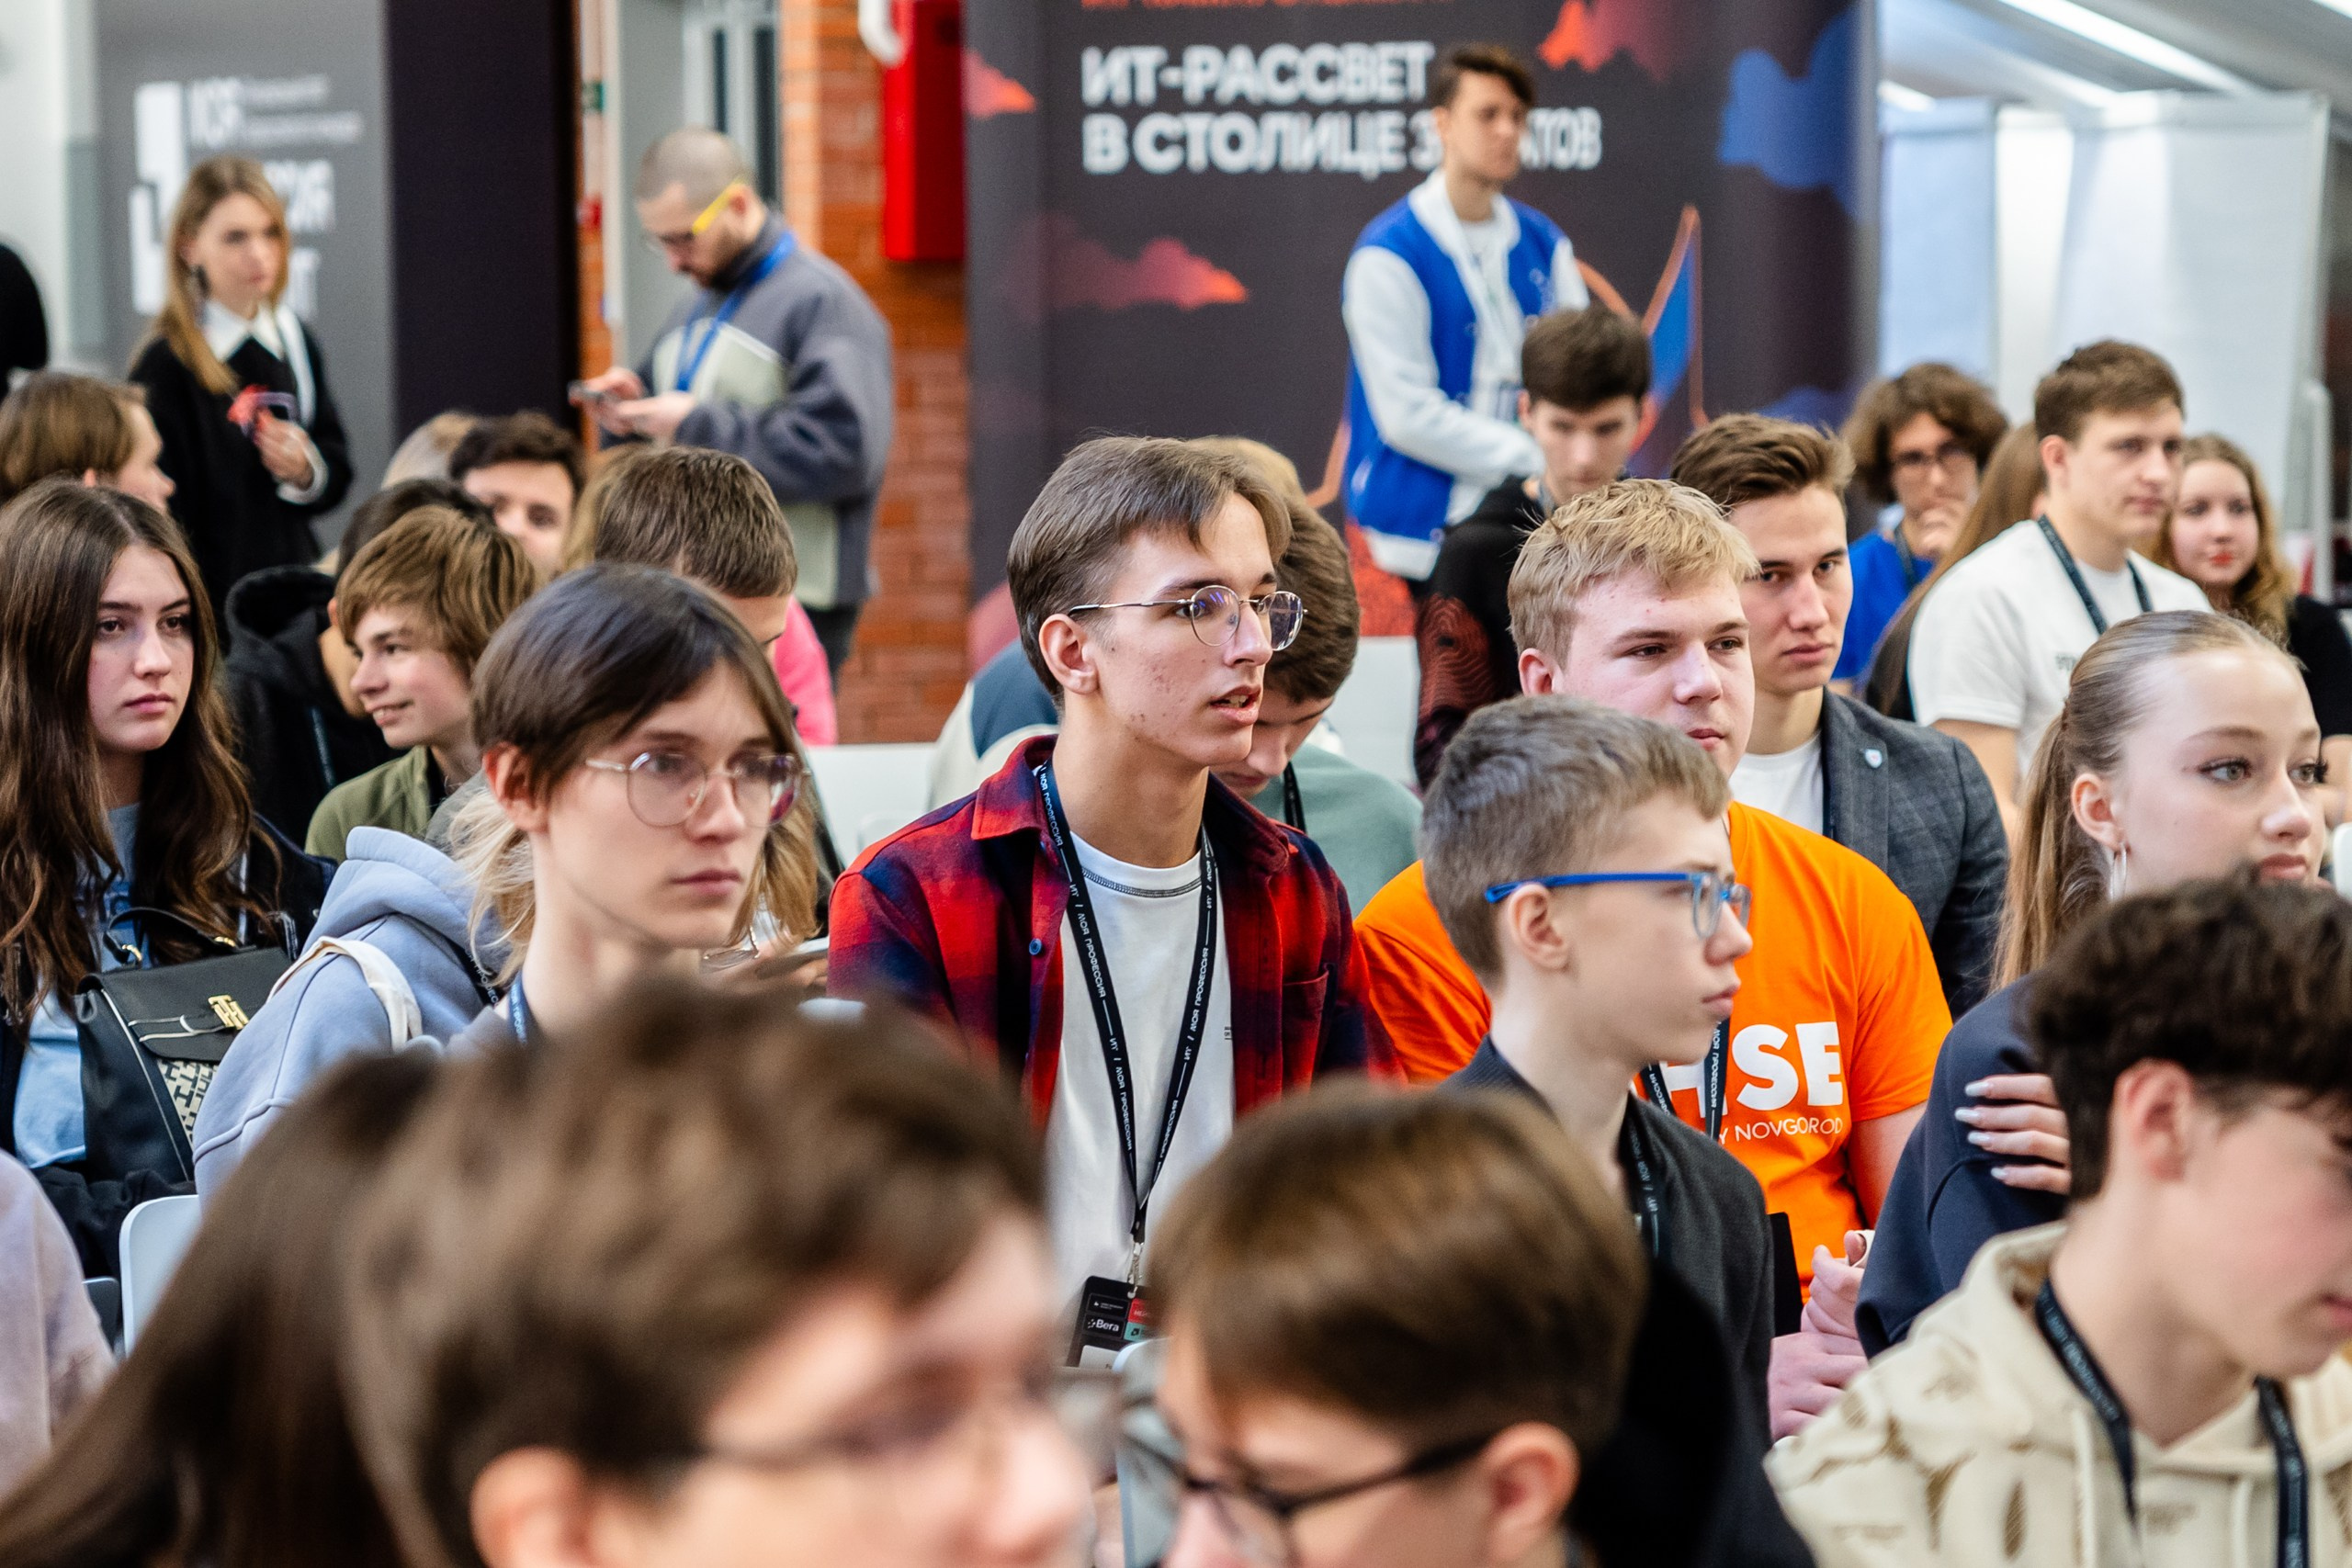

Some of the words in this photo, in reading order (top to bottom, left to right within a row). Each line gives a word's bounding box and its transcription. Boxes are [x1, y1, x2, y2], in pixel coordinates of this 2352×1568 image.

[1081, 40, 1435, 107] ИТ-РАССВЕТ
[1082, 112, 1128, 175] В
[1131, 107, 1407, 180] СТОЛИЦЕ
[1044, 792, 1064, 847] ПРОФЕССИЯ
[1078, 912, 1091, 936] МОЯ
[1084, 938, 1107, 998] ПРОФЕССИЯ
[1194, 947, 1209, 1007] ПРОФЕССИЯ
[1190, 1009, 1200, 1032] МОЯ
[1115, 1066, 1126, 1089] МОЯ
[1711, 1052, 1721, 1109] ПРОФЕССИЯ
[1119, 1091, 1132, 1151] ПРОФЕССИЯ
[1735, 1116, 1843, 1142] NOVGOROD
